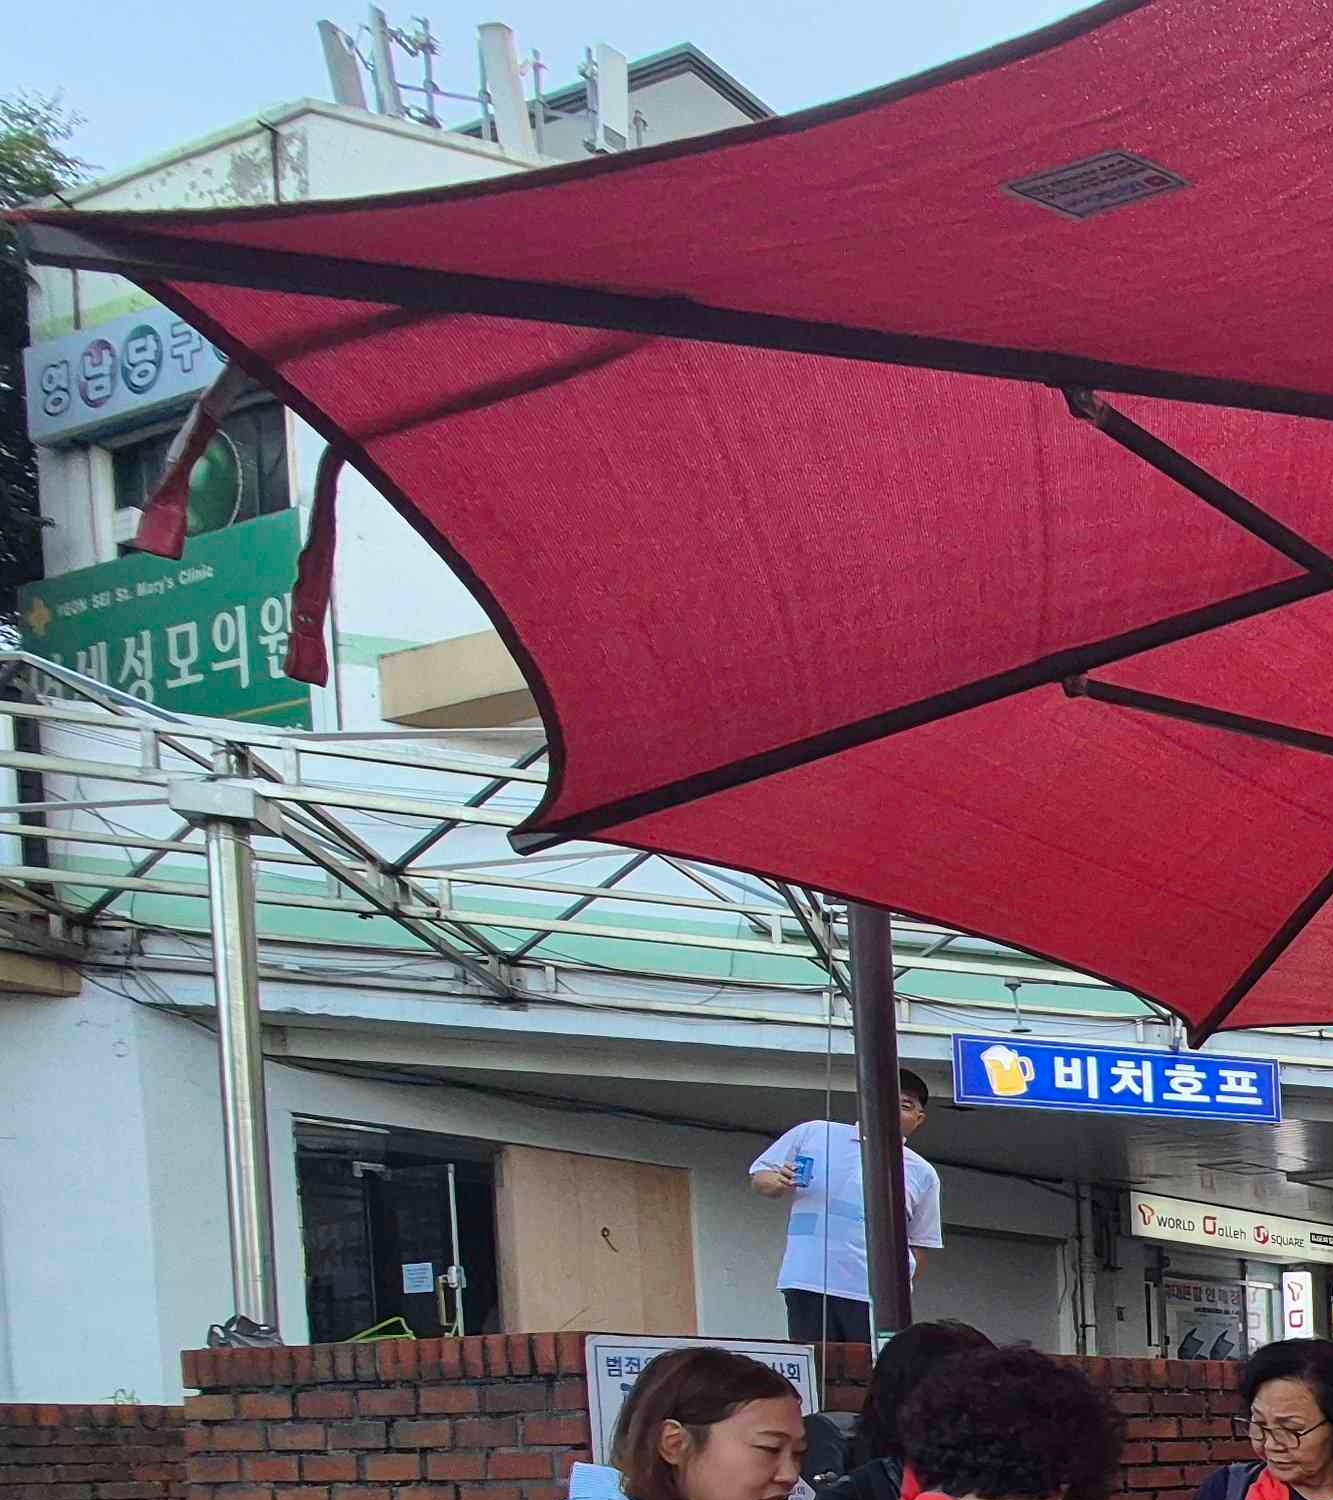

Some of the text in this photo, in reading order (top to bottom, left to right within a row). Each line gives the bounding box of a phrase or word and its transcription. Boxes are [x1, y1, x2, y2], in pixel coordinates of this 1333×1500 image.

[41, 320, 229, 416] 영남당구
[1053, 1055, 1263, 1106] 비치호프
[1157, 1215, 1195, 1232] WORLD
[1217, 1225, 1247, 1241] olleh
[1271, 1234, 1305, 1248] SQUARE
